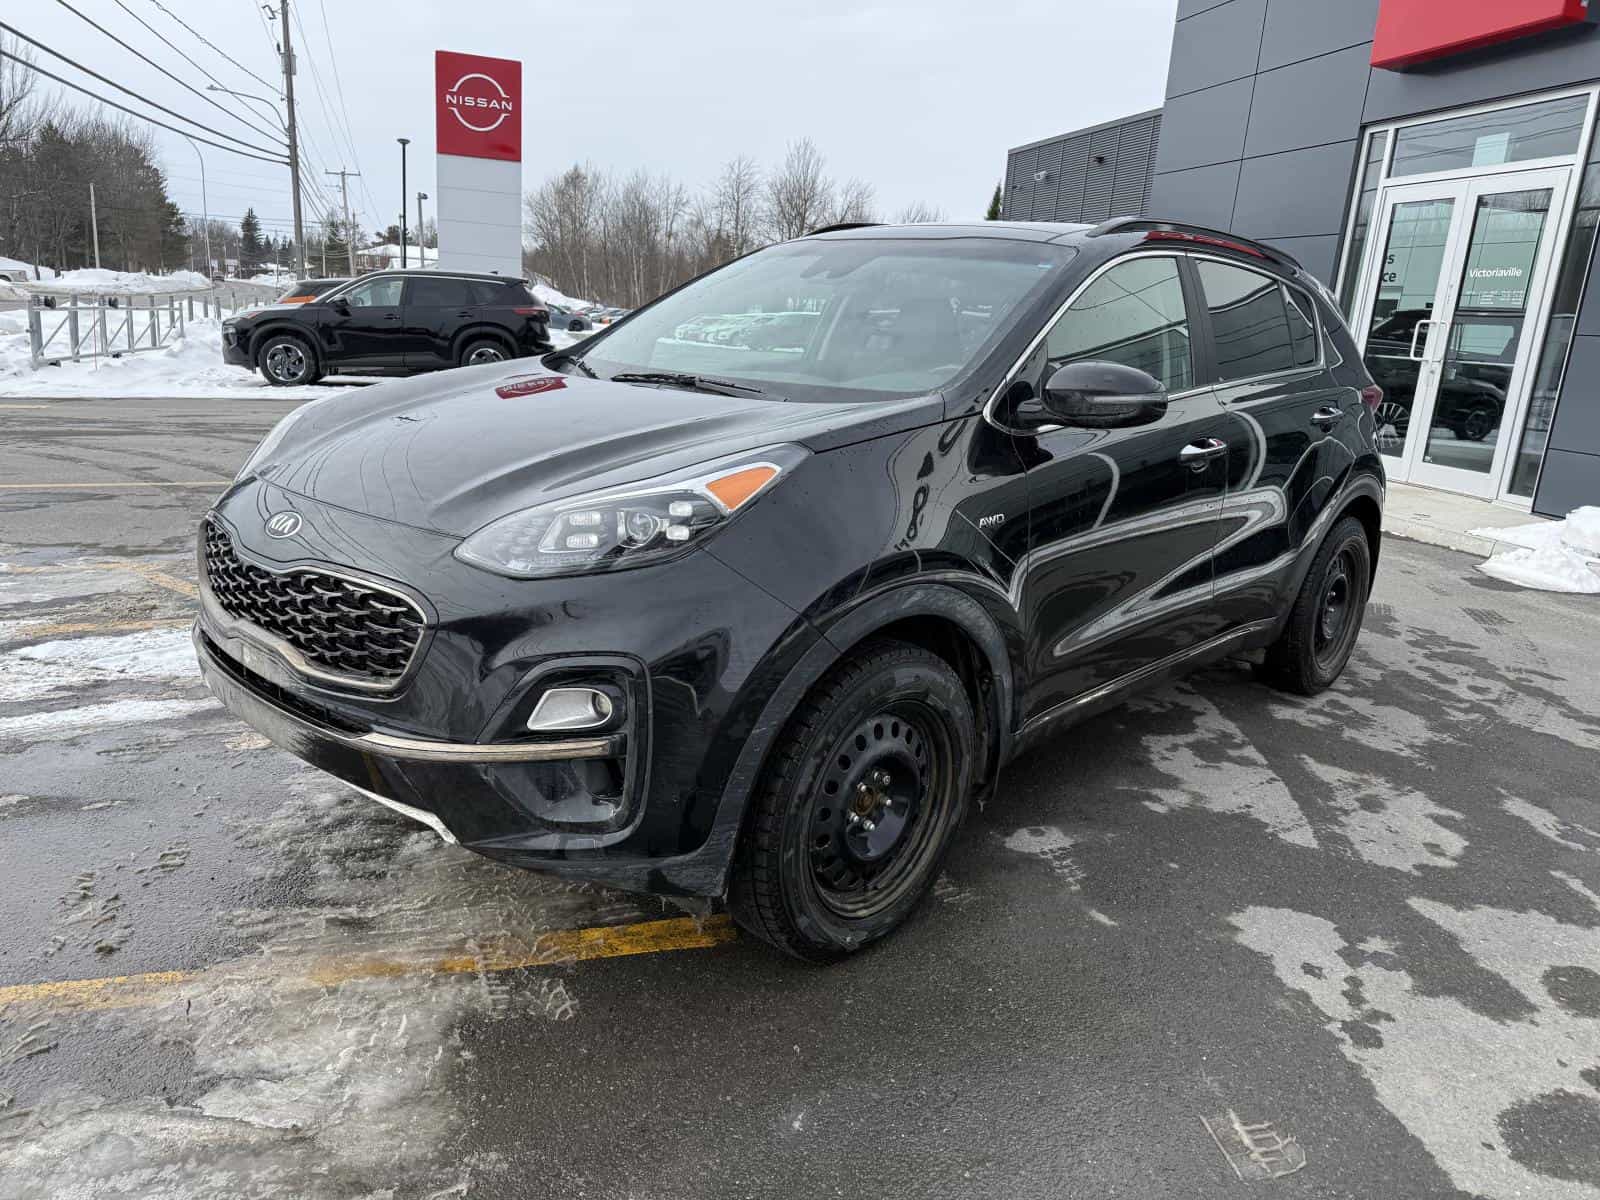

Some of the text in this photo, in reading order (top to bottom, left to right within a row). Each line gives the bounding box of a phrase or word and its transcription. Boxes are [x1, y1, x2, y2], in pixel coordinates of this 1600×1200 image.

[445, 94, 513, 111] NISSAN
[1469, 266, 1523, 278] Victoriaville
[269, 514, 295, 534] KIA
[979, 513, 1005, 528] AWD
